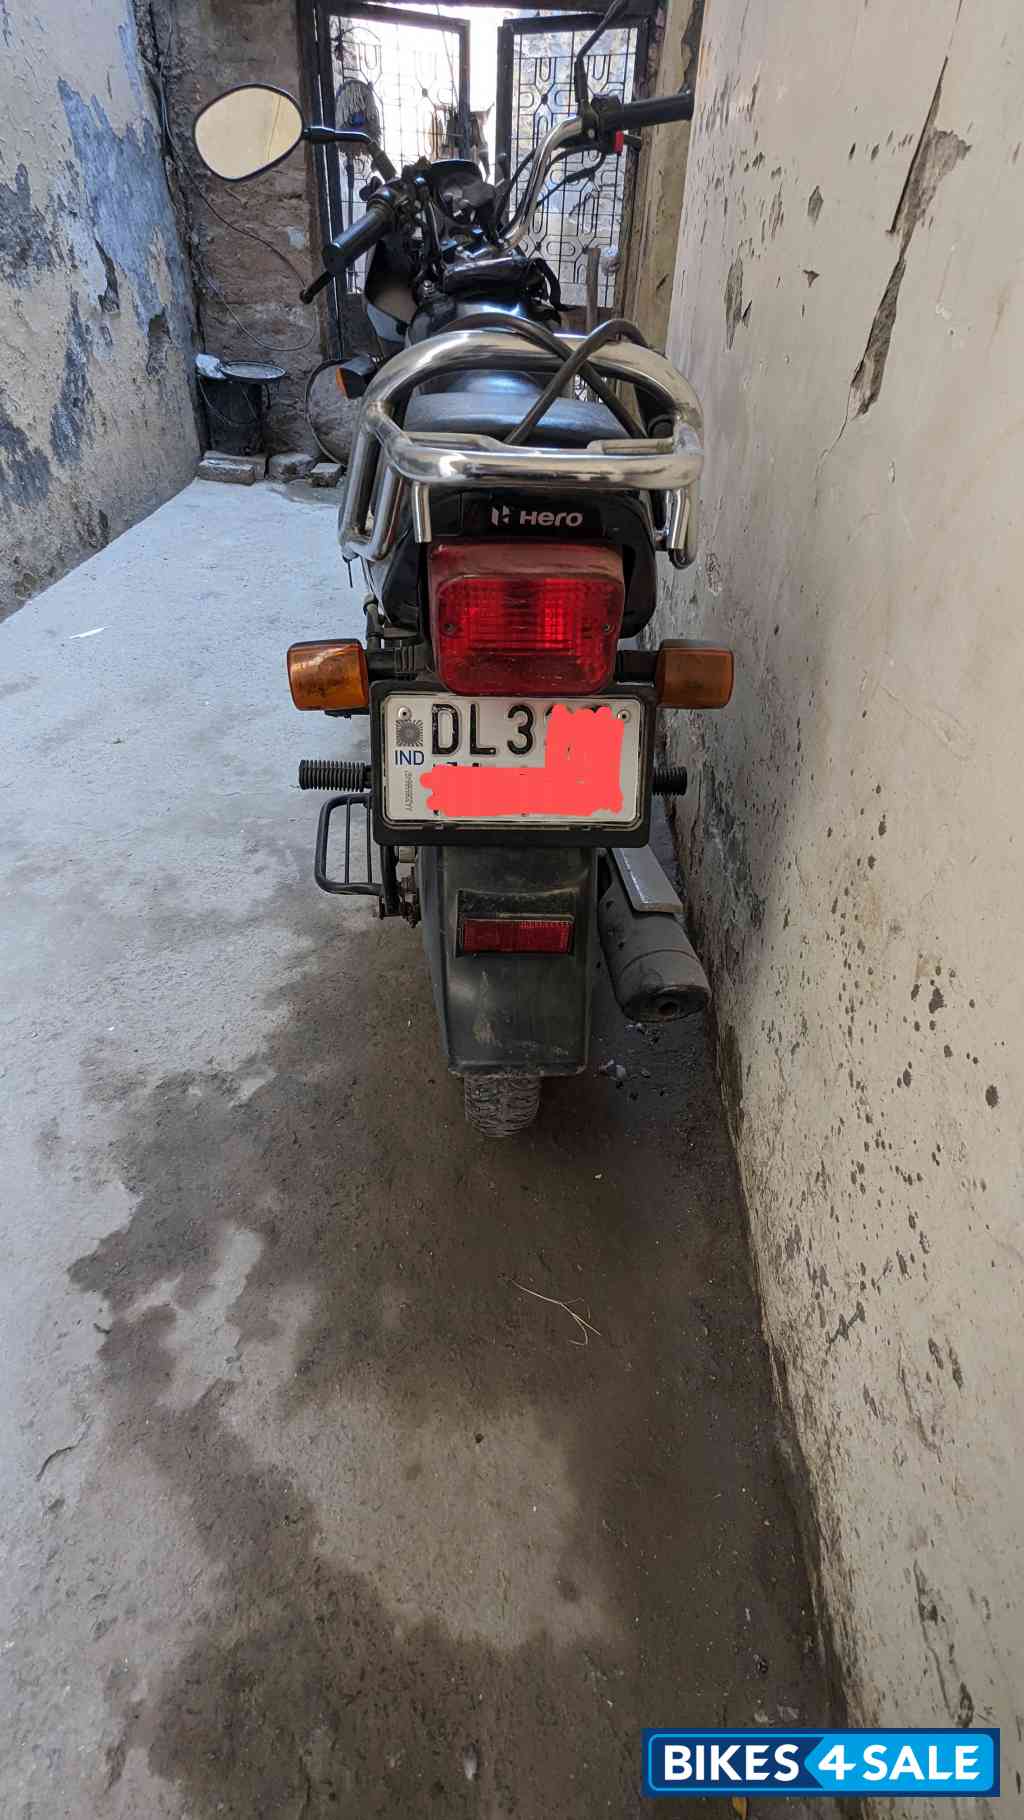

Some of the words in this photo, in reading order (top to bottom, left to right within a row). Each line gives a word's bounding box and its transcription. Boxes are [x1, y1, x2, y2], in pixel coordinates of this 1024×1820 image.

[519, 510, 584, 527] Hero
[431, 703, 598, 755] DL3
[394, 750, 425, 766] IND
